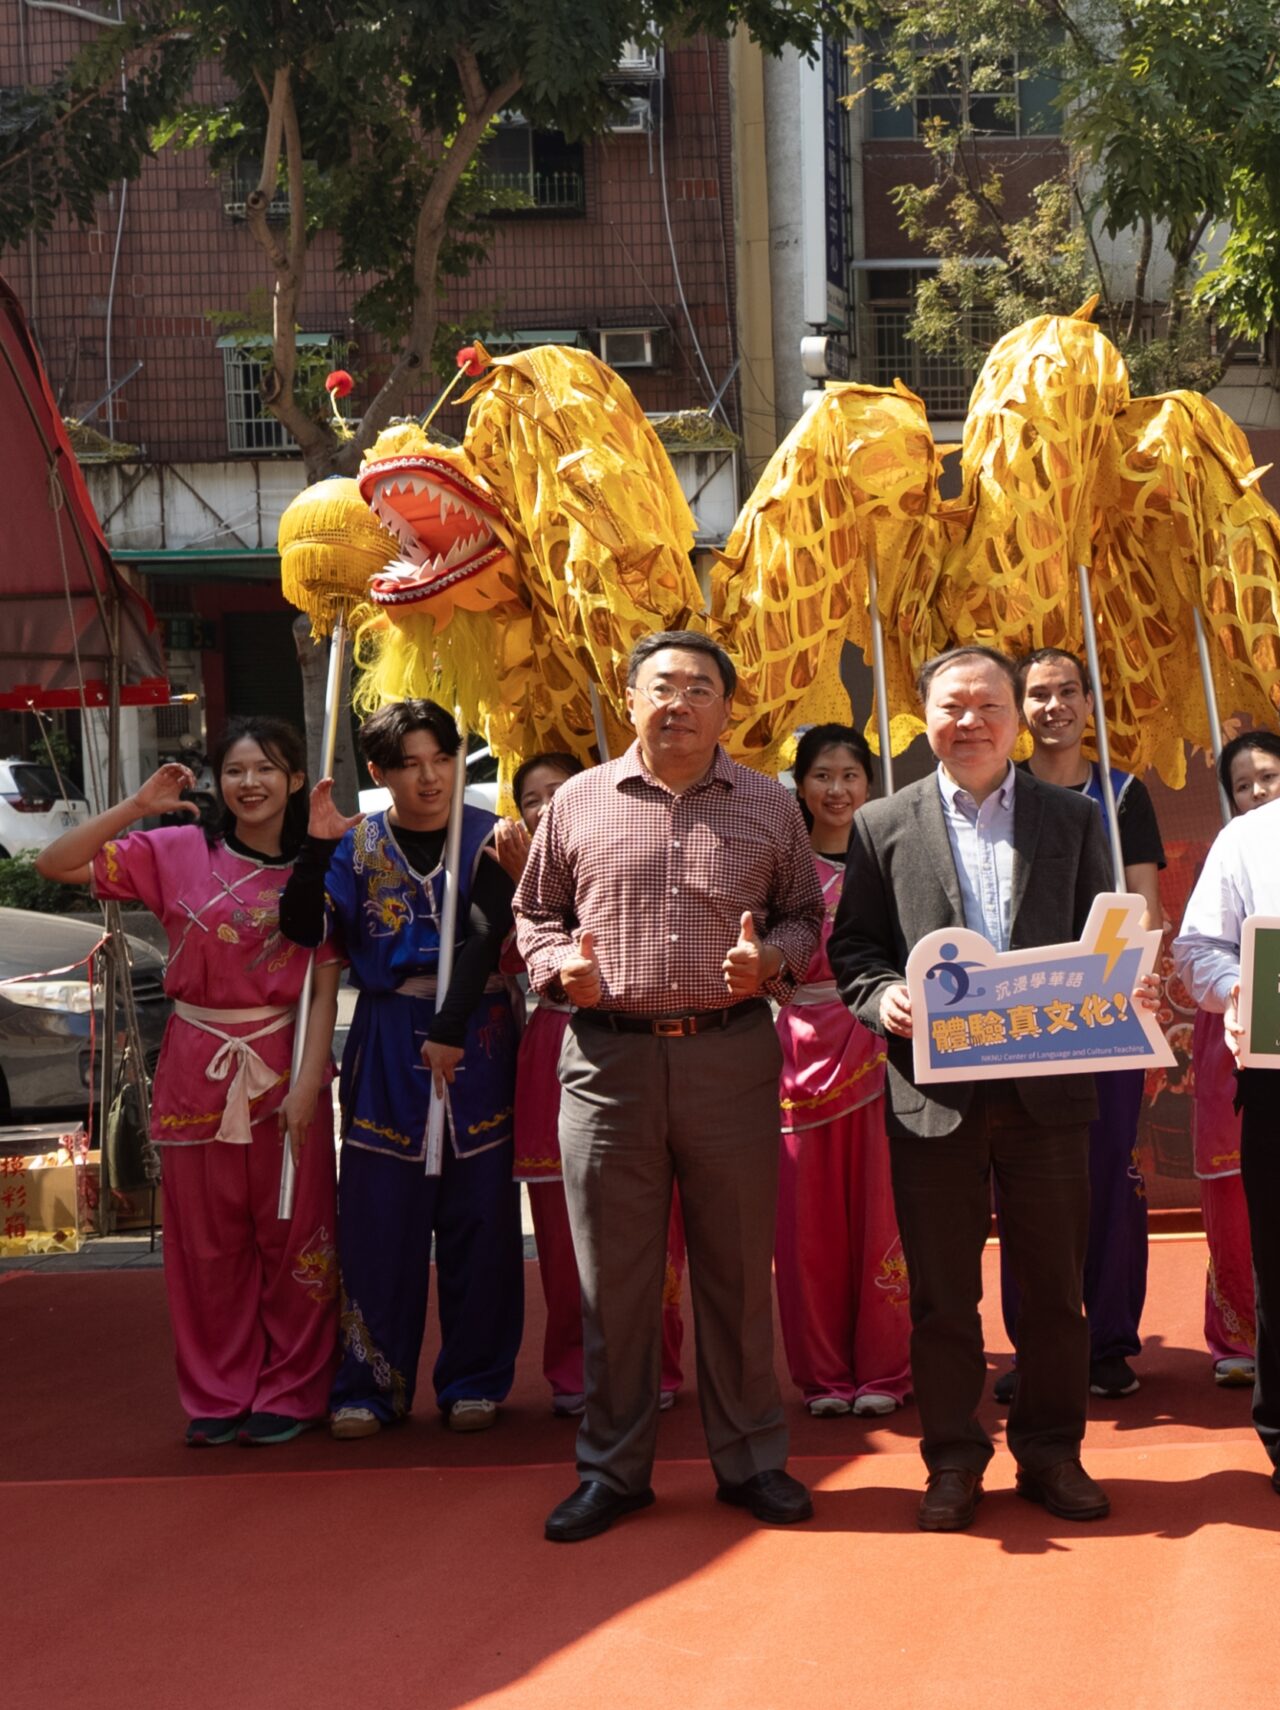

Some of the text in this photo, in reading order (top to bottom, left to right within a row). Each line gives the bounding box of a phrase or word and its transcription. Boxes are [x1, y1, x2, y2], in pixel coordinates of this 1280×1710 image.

[996, 971, 1085, 1000] 沉浸學華語
[931, 992, 1128, 1053] 體驗真文化!
[1004, 1052, 1027, 1061] Center
[1029, 1050, 1036, 1060] of
[1037, 1048, 1071, 1060] Language
[1072, 1048, 1086, 1056] and
[1087, 1046, 1113, 1056] Culture
[1113, 1044, 1145, 1055] Teaching
